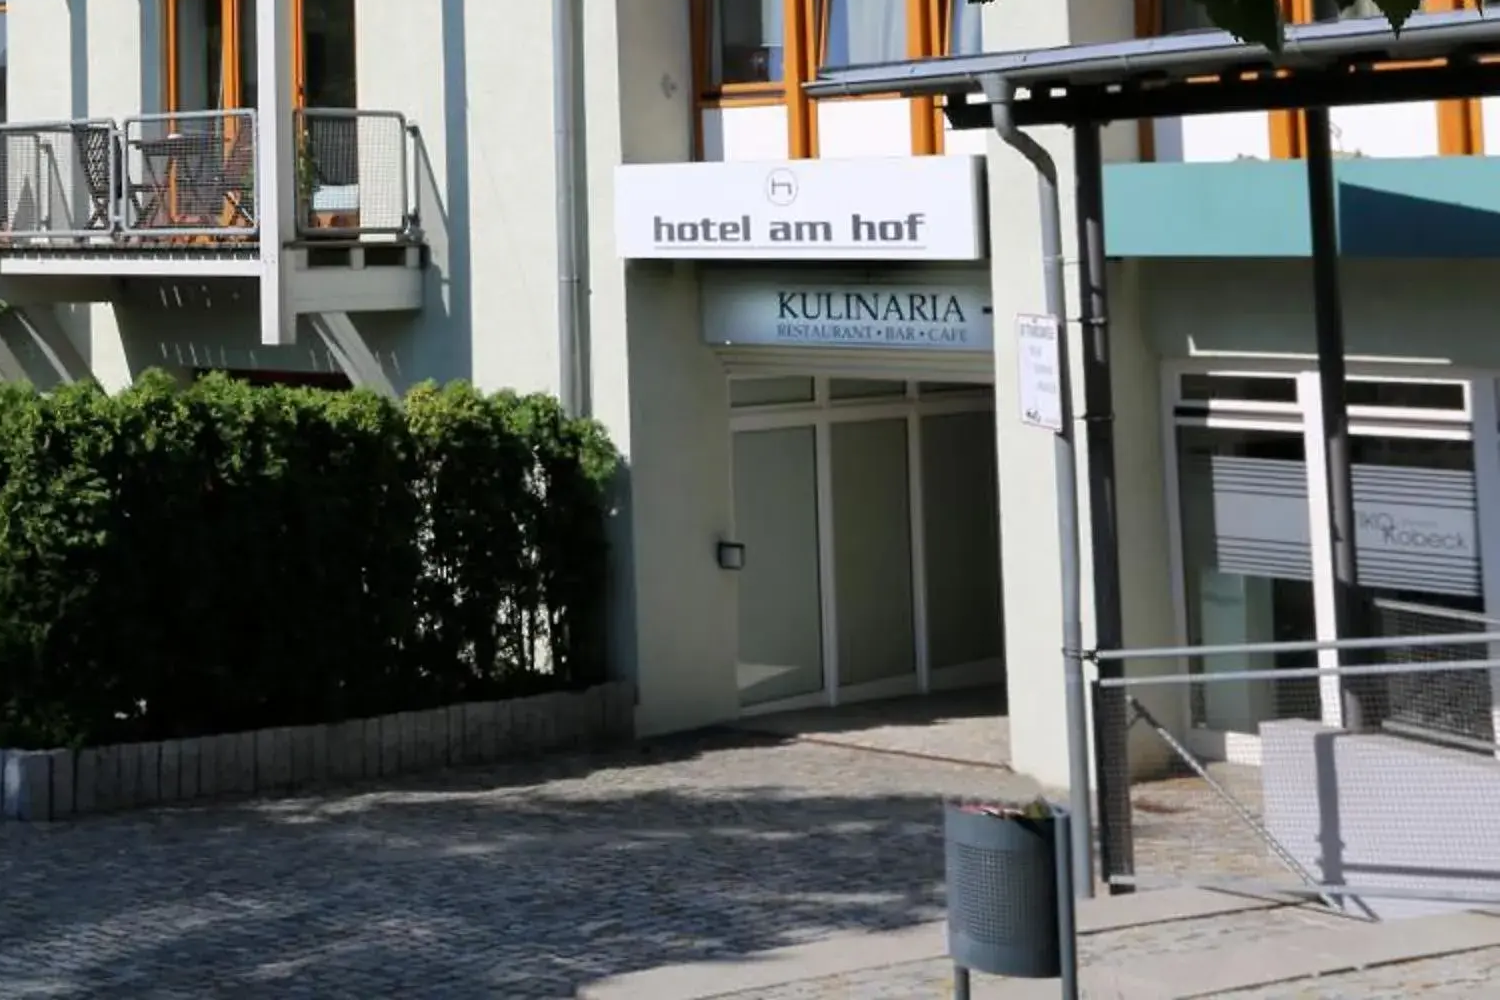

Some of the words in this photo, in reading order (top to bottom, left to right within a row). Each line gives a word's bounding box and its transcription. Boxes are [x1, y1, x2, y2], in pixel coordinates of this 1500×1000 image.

[653, 215, 751, 242] hotel
[769, 221, 832, 242] am
[851, 213, 926, 242] hof
[777, 291, 967, 323] KULINARIA
[777, 323, 873, 340] RESTAURANT
[885, 326, 916, 341] BAR
